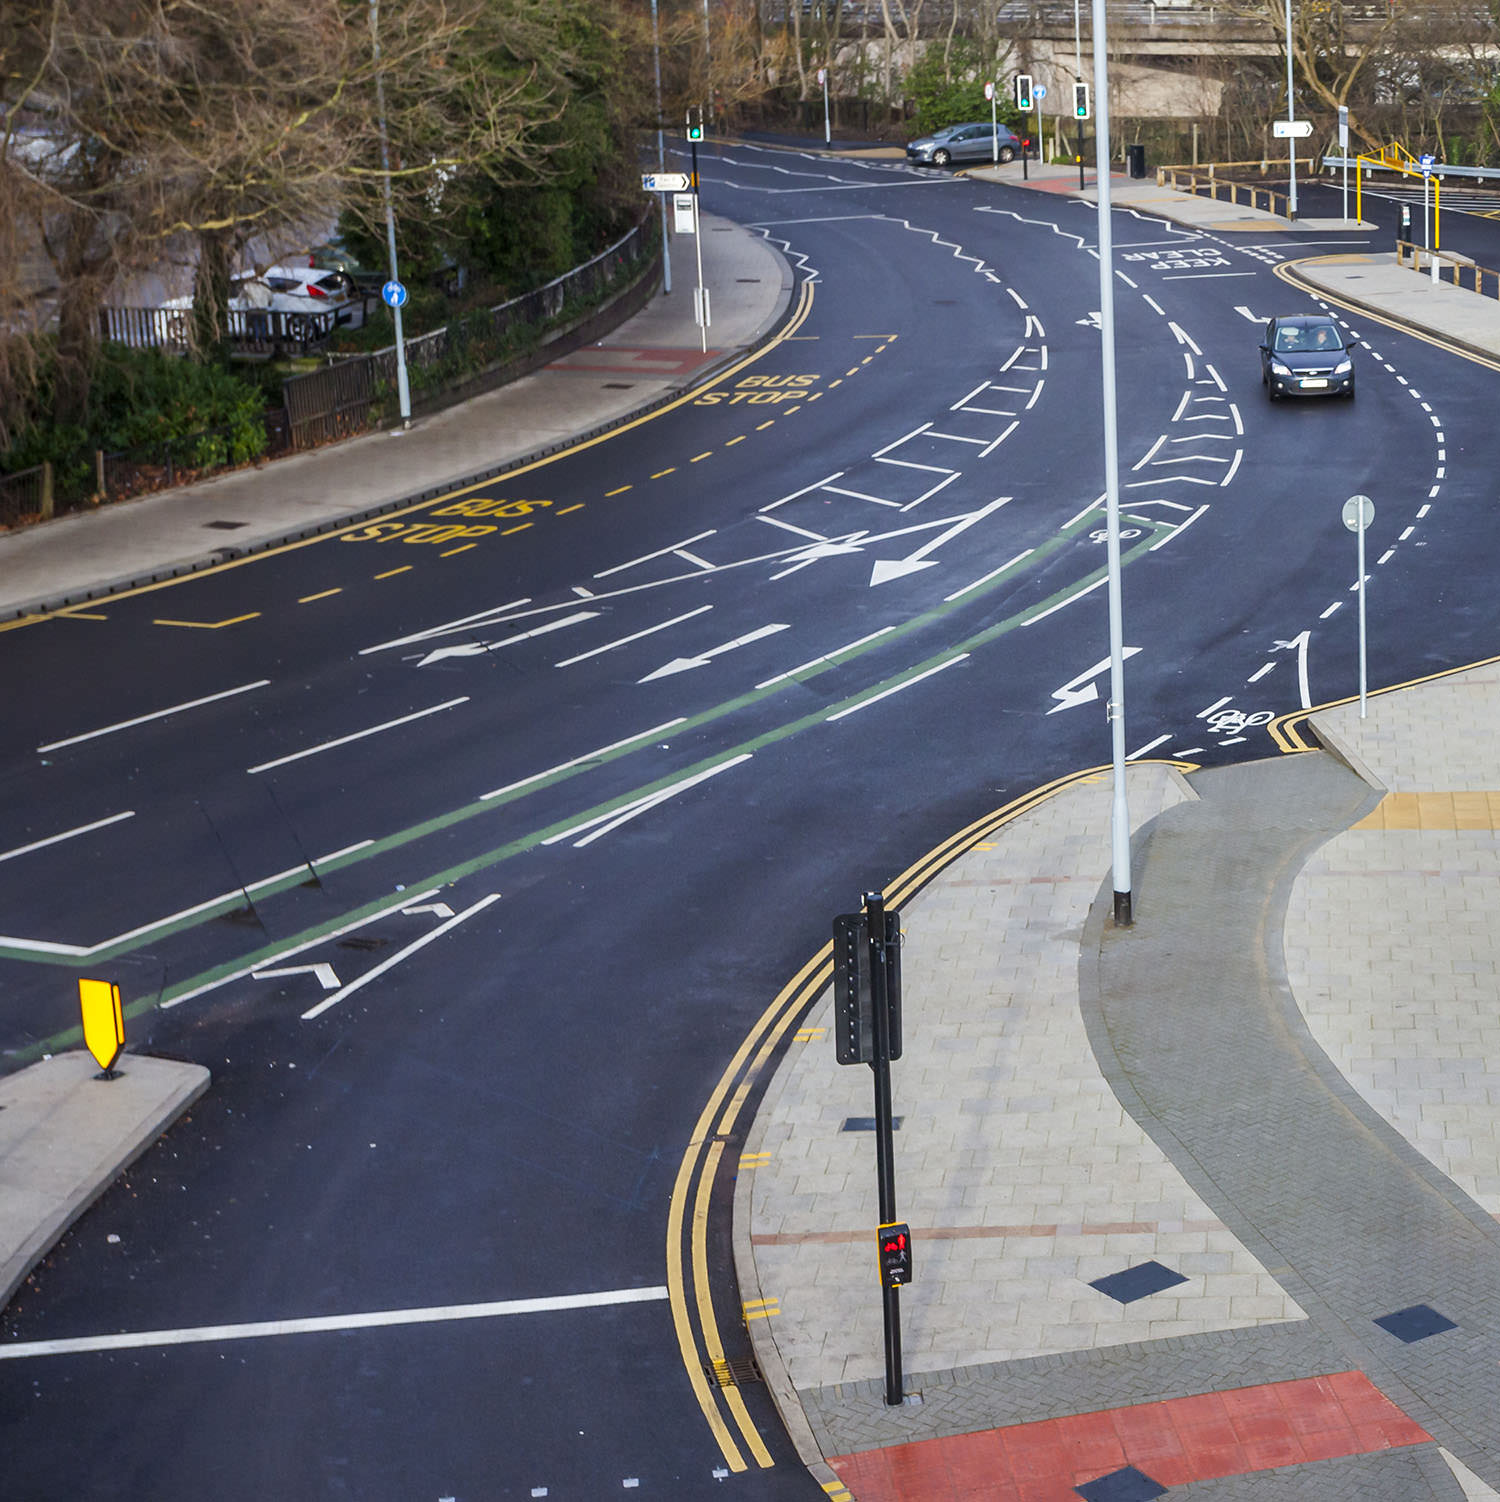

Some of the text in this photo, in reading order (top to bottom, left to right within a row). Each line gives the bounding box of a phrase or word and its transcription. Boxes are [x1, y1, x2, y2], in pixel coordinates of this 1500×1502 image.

[1121, 248, 1222, 261] CLEAR
[1150, 257, 1232, 270] KEEP
[735, 374, 821, 388] BUS
[693, 390, 809, 406] STOP
[429, 498, 553, 518] BUS
[340, 522, 499, 544] STOP
